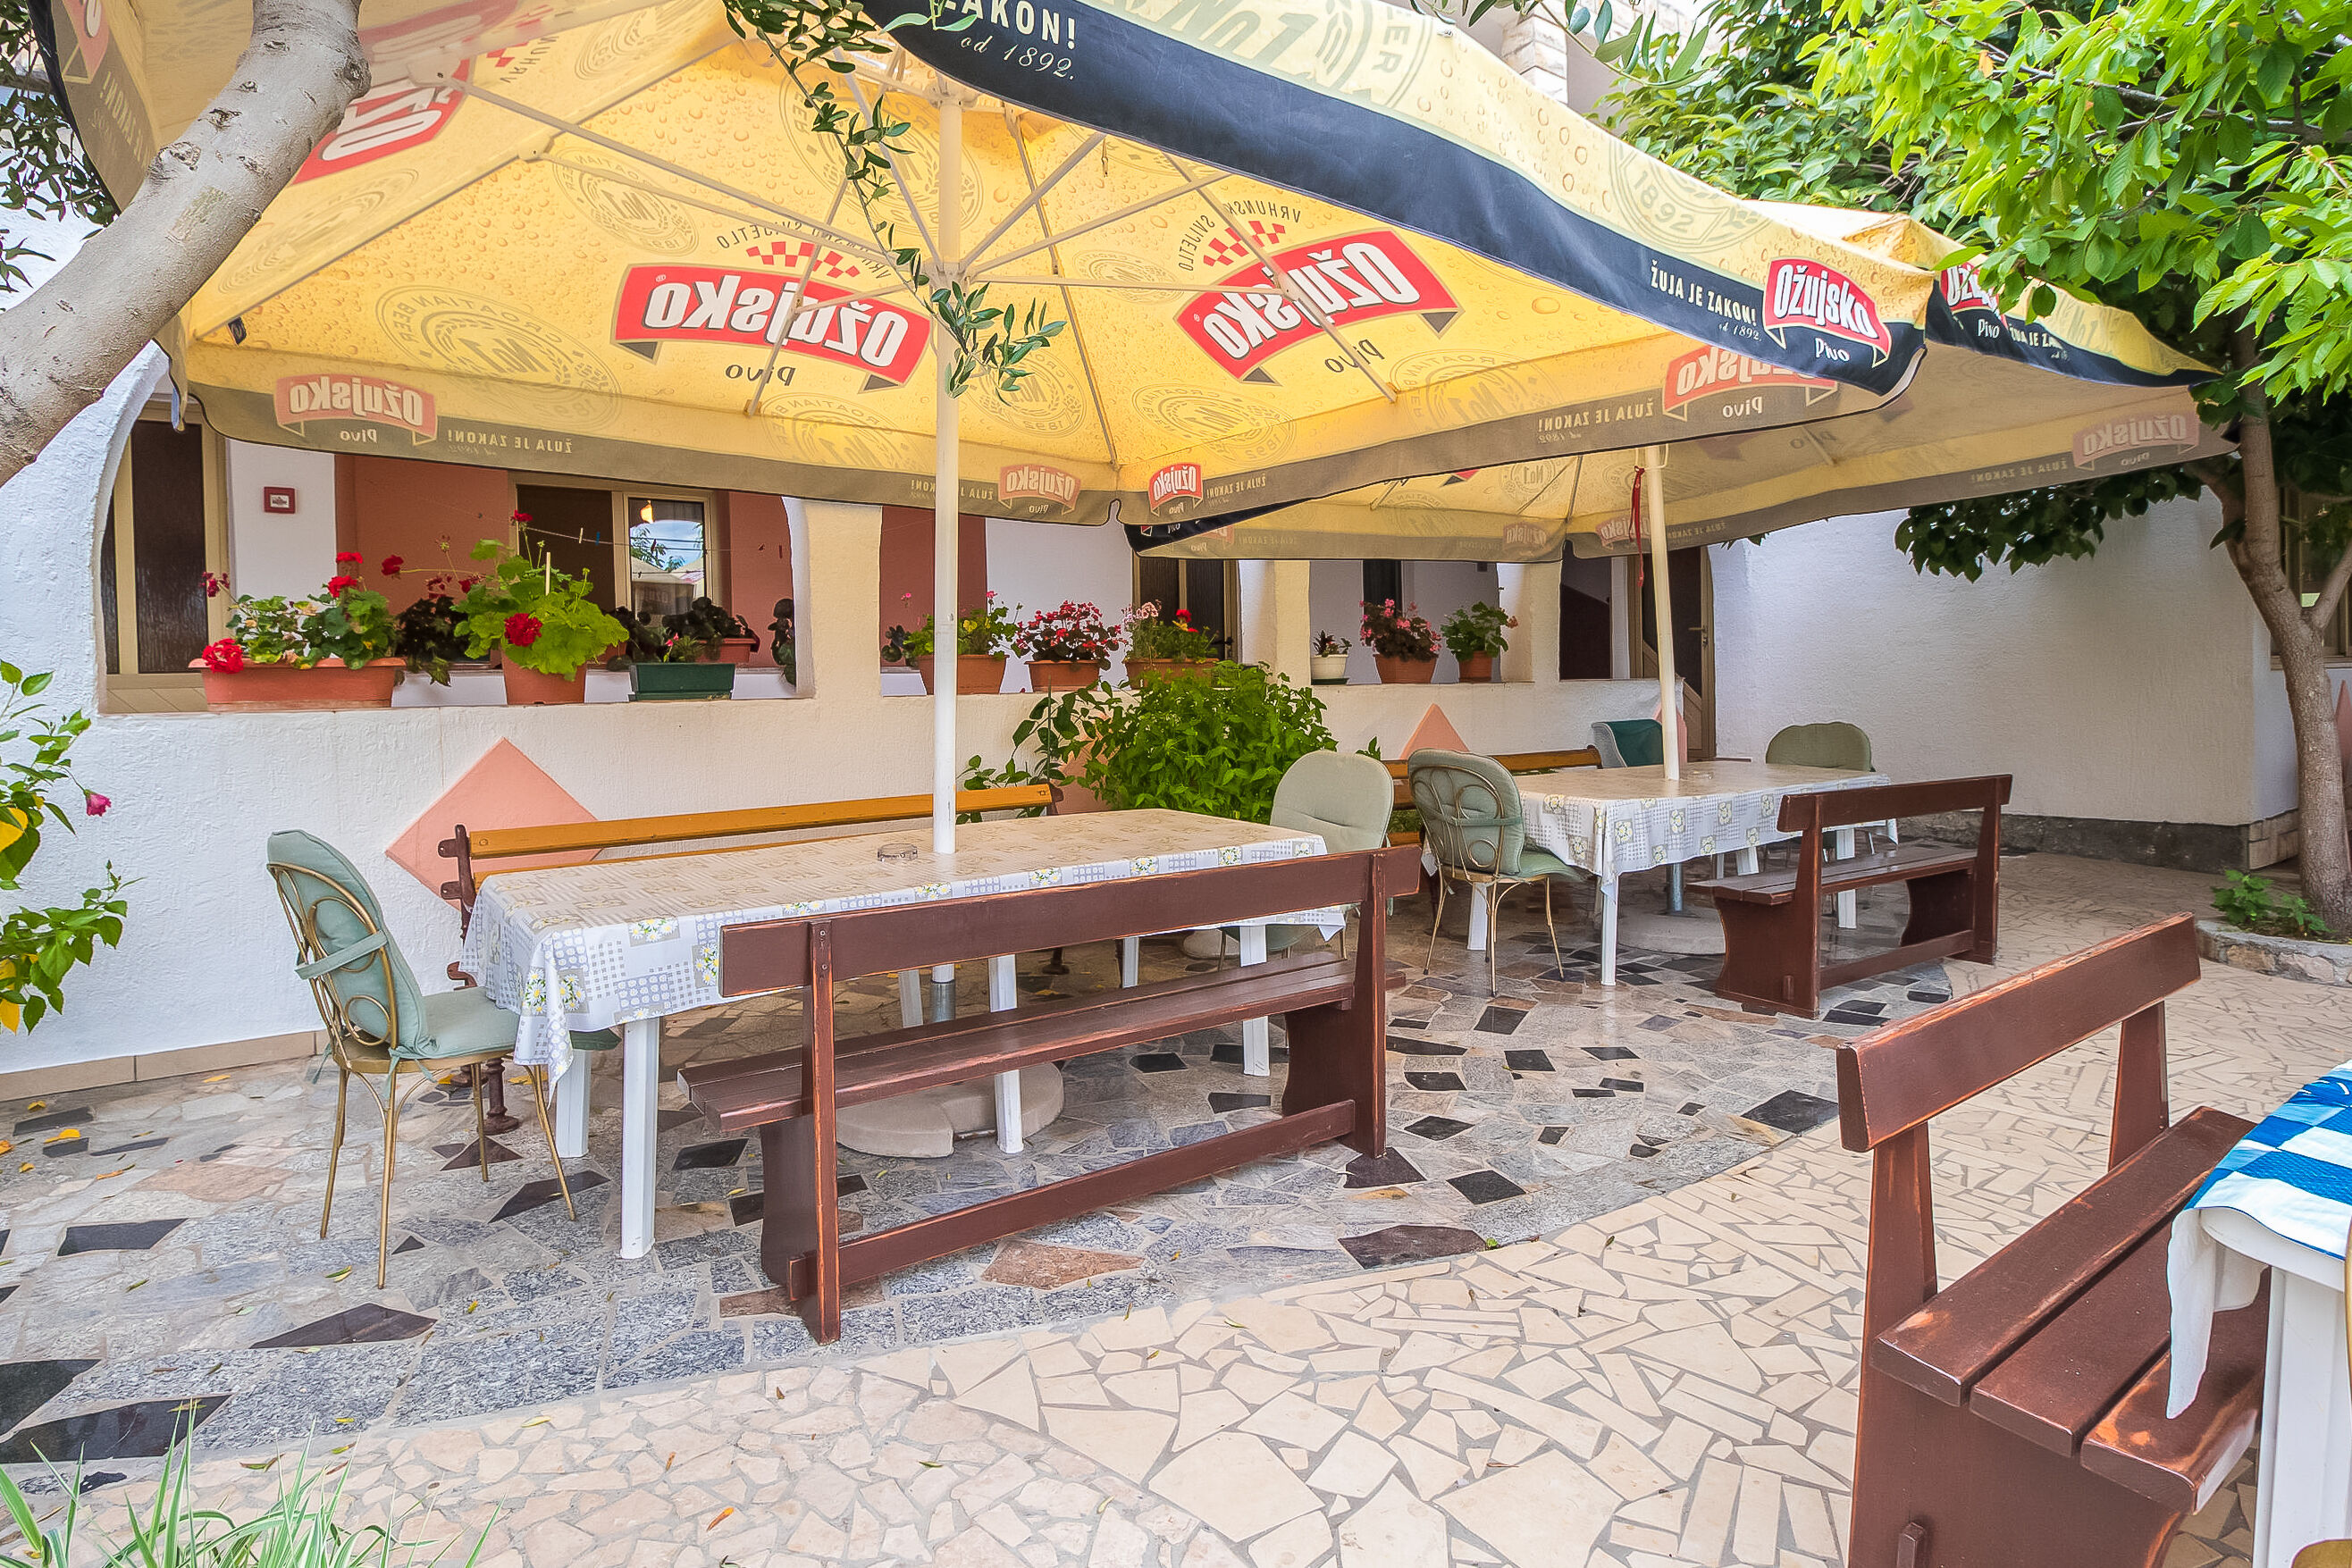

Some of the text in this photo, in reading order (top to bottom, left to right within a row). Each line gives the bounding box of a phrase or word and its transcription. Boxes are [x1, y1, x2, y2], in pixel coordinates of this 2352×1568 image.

[945, 0, 1075, 50] AKON!
[961, 36, 1074, 80] od 1892.
[1634, 172, 1694, 232] 1892
[1651, 259, 1757, 326] ŽUJA JE ZAKON!
[1773, 264, 1878, 340] Ožujsko
